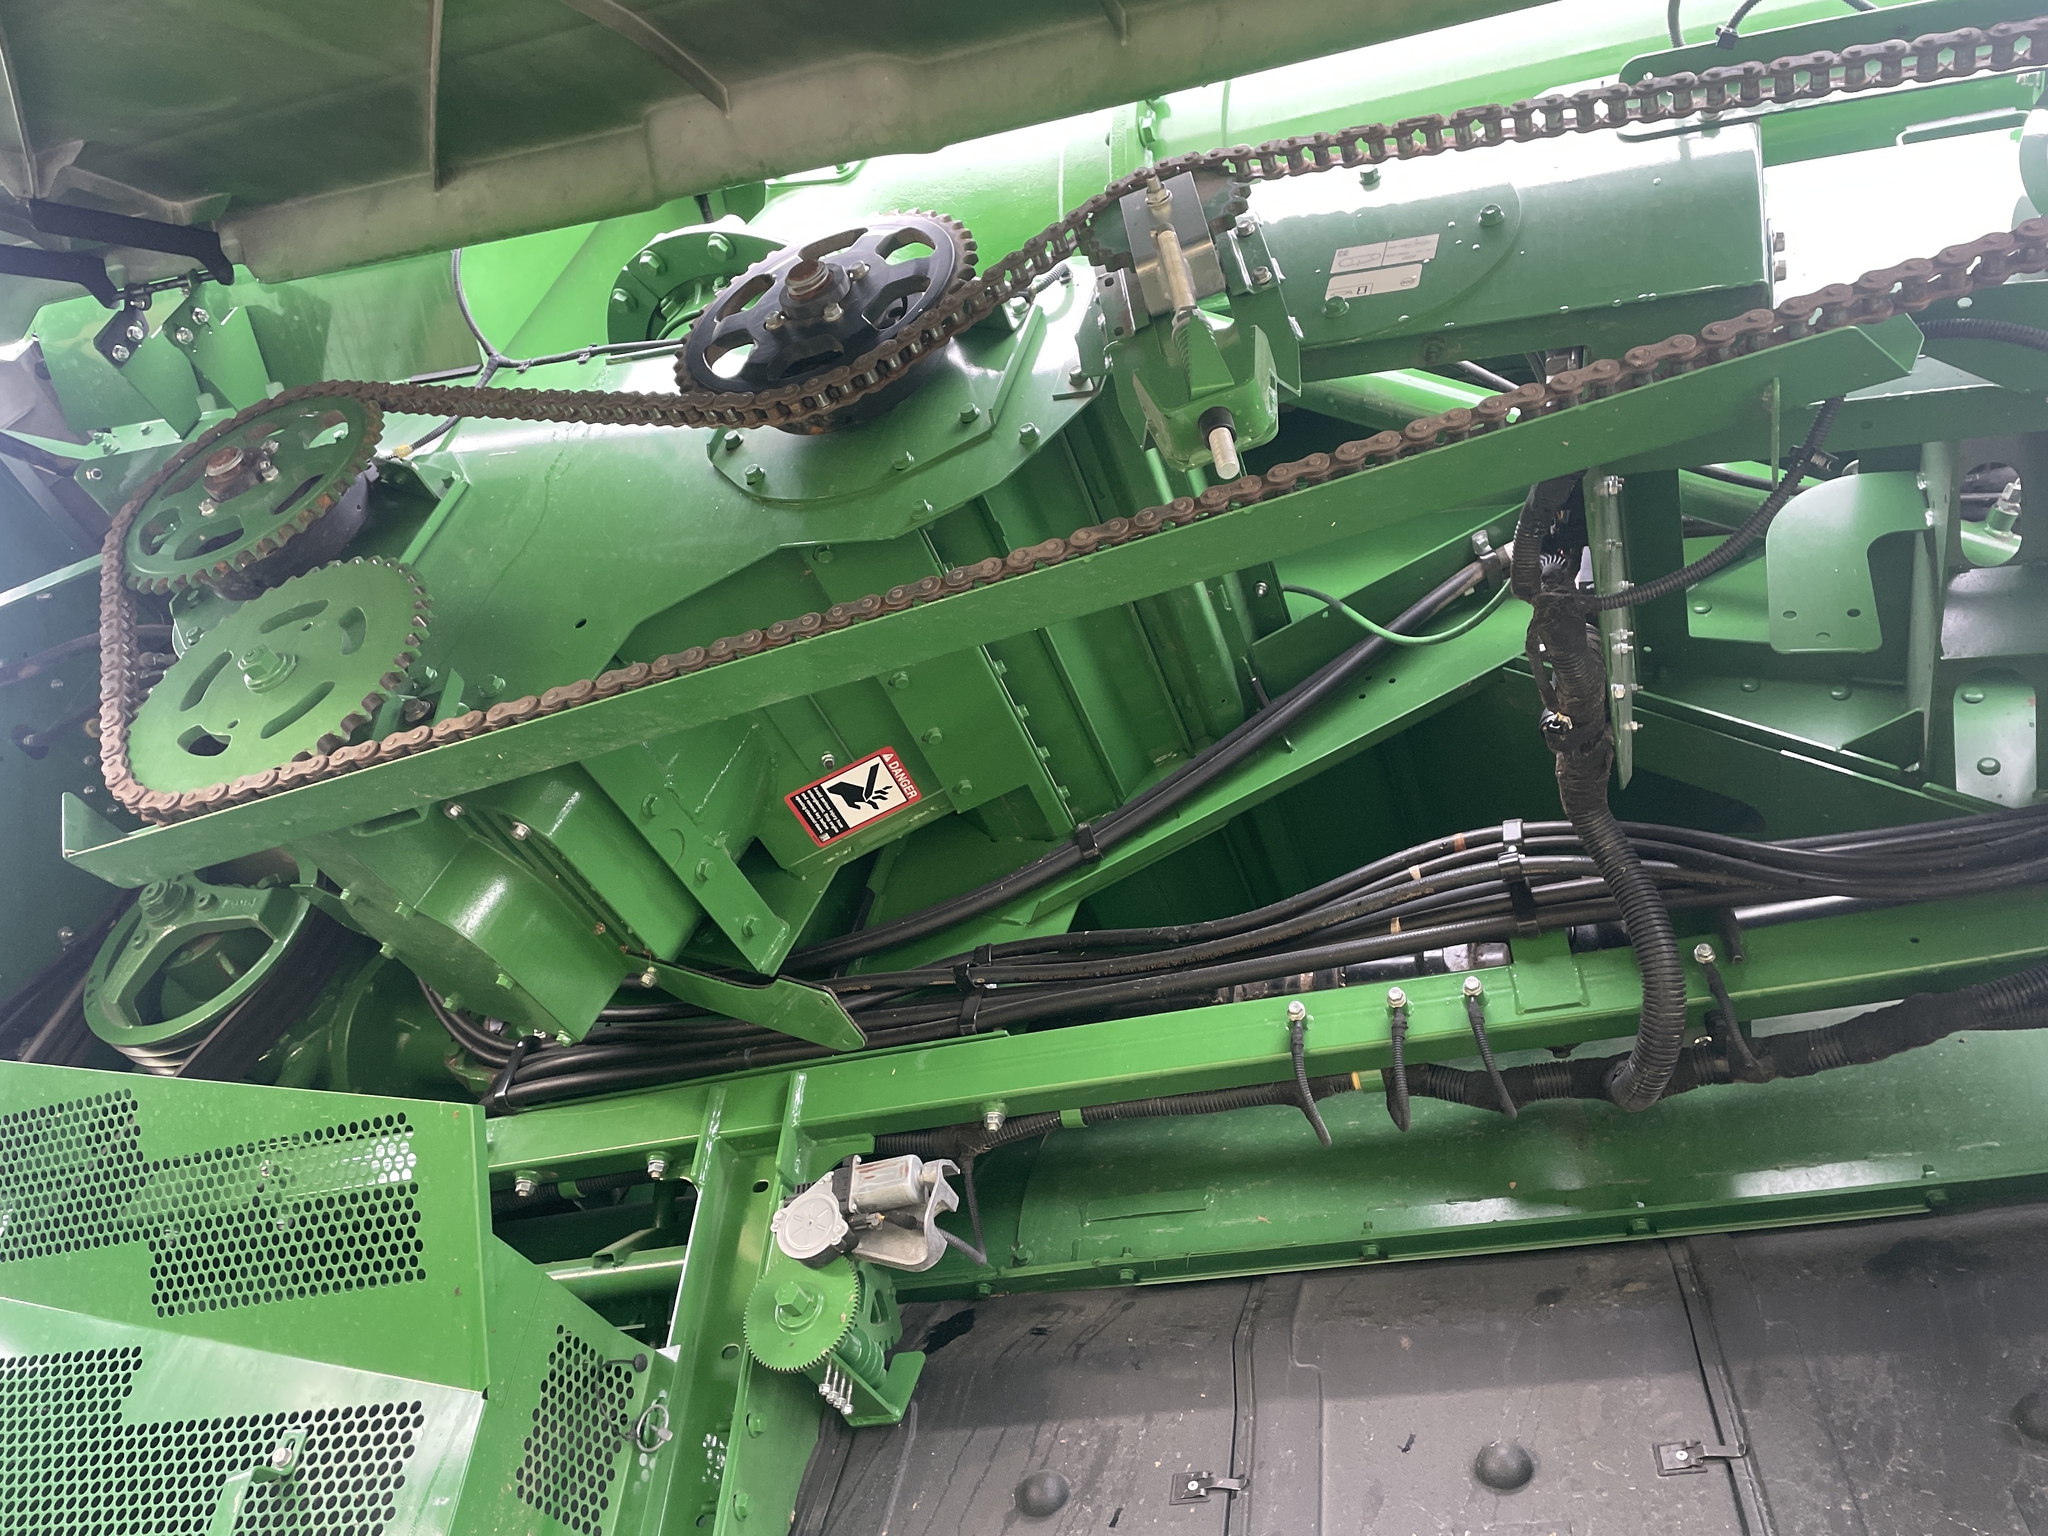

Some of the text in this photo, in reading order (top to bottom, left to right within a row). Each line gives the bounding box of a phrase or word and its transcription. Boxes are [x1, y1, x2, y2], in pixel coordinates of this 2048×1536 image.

[889, 761, 917, 798] DANGER
[820, 797, 831, 810] serious
[829, 809, 838, 820] injury
